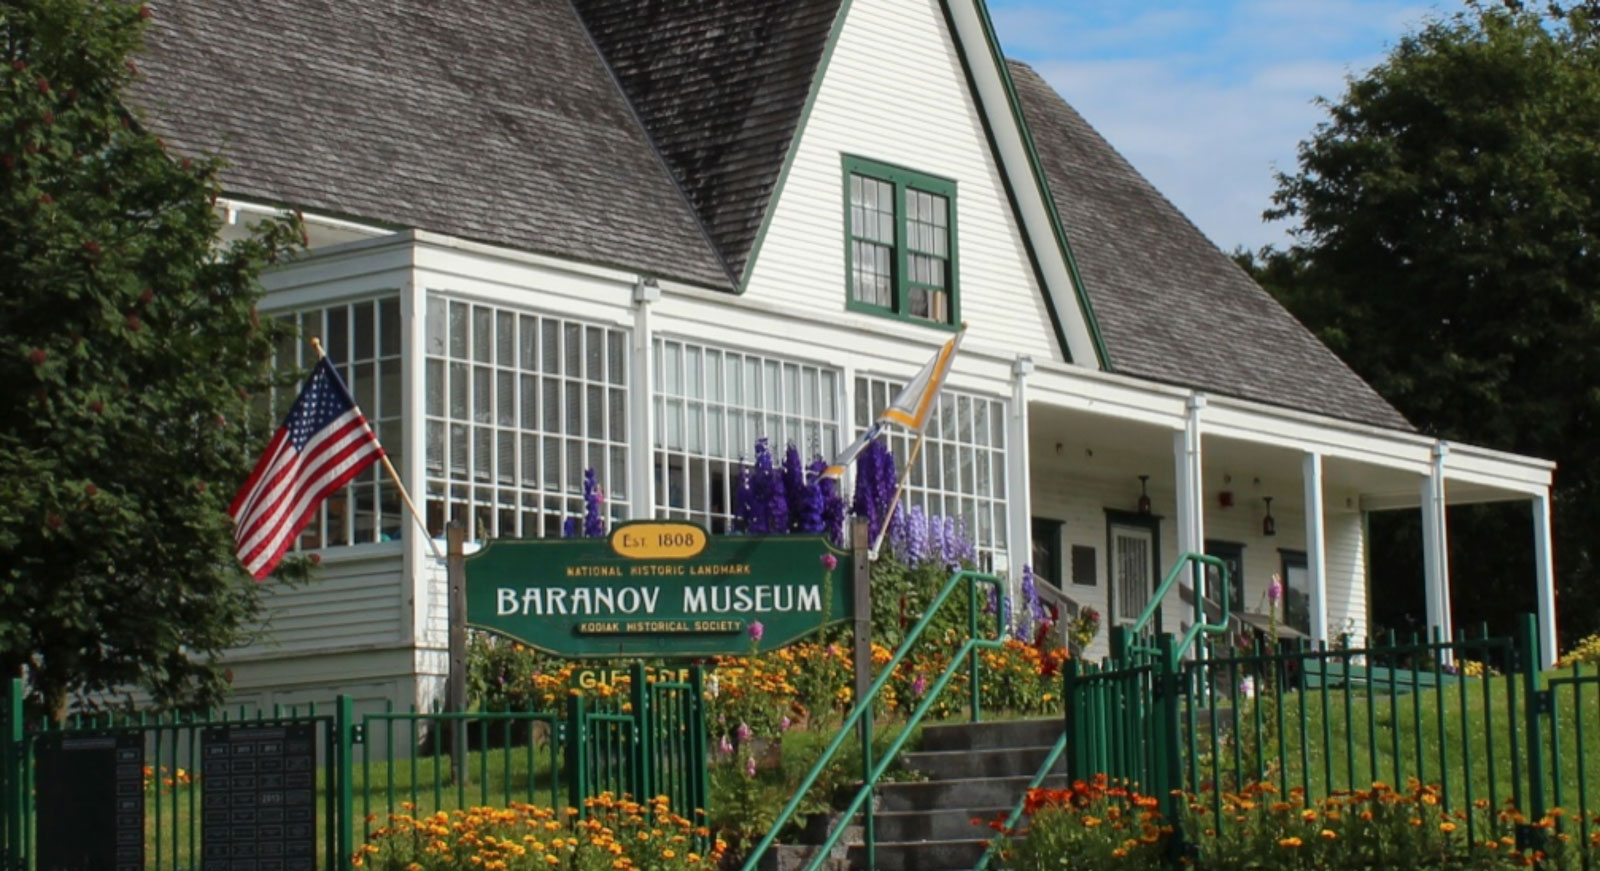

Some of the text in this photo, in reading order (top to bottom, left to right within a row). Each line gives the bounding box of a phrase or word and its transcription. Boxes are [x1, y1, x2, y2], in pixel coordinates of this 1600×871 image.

[658, 532, 694, 548] 1808
[566, 563, 751, 577] NATIONAL HISTORIC LANDMARK
[496, 584, 822, 616] BARANOV MUSEUM
[580, 620, 742, 633] KODIAK HISTORICAL SOCIETY
